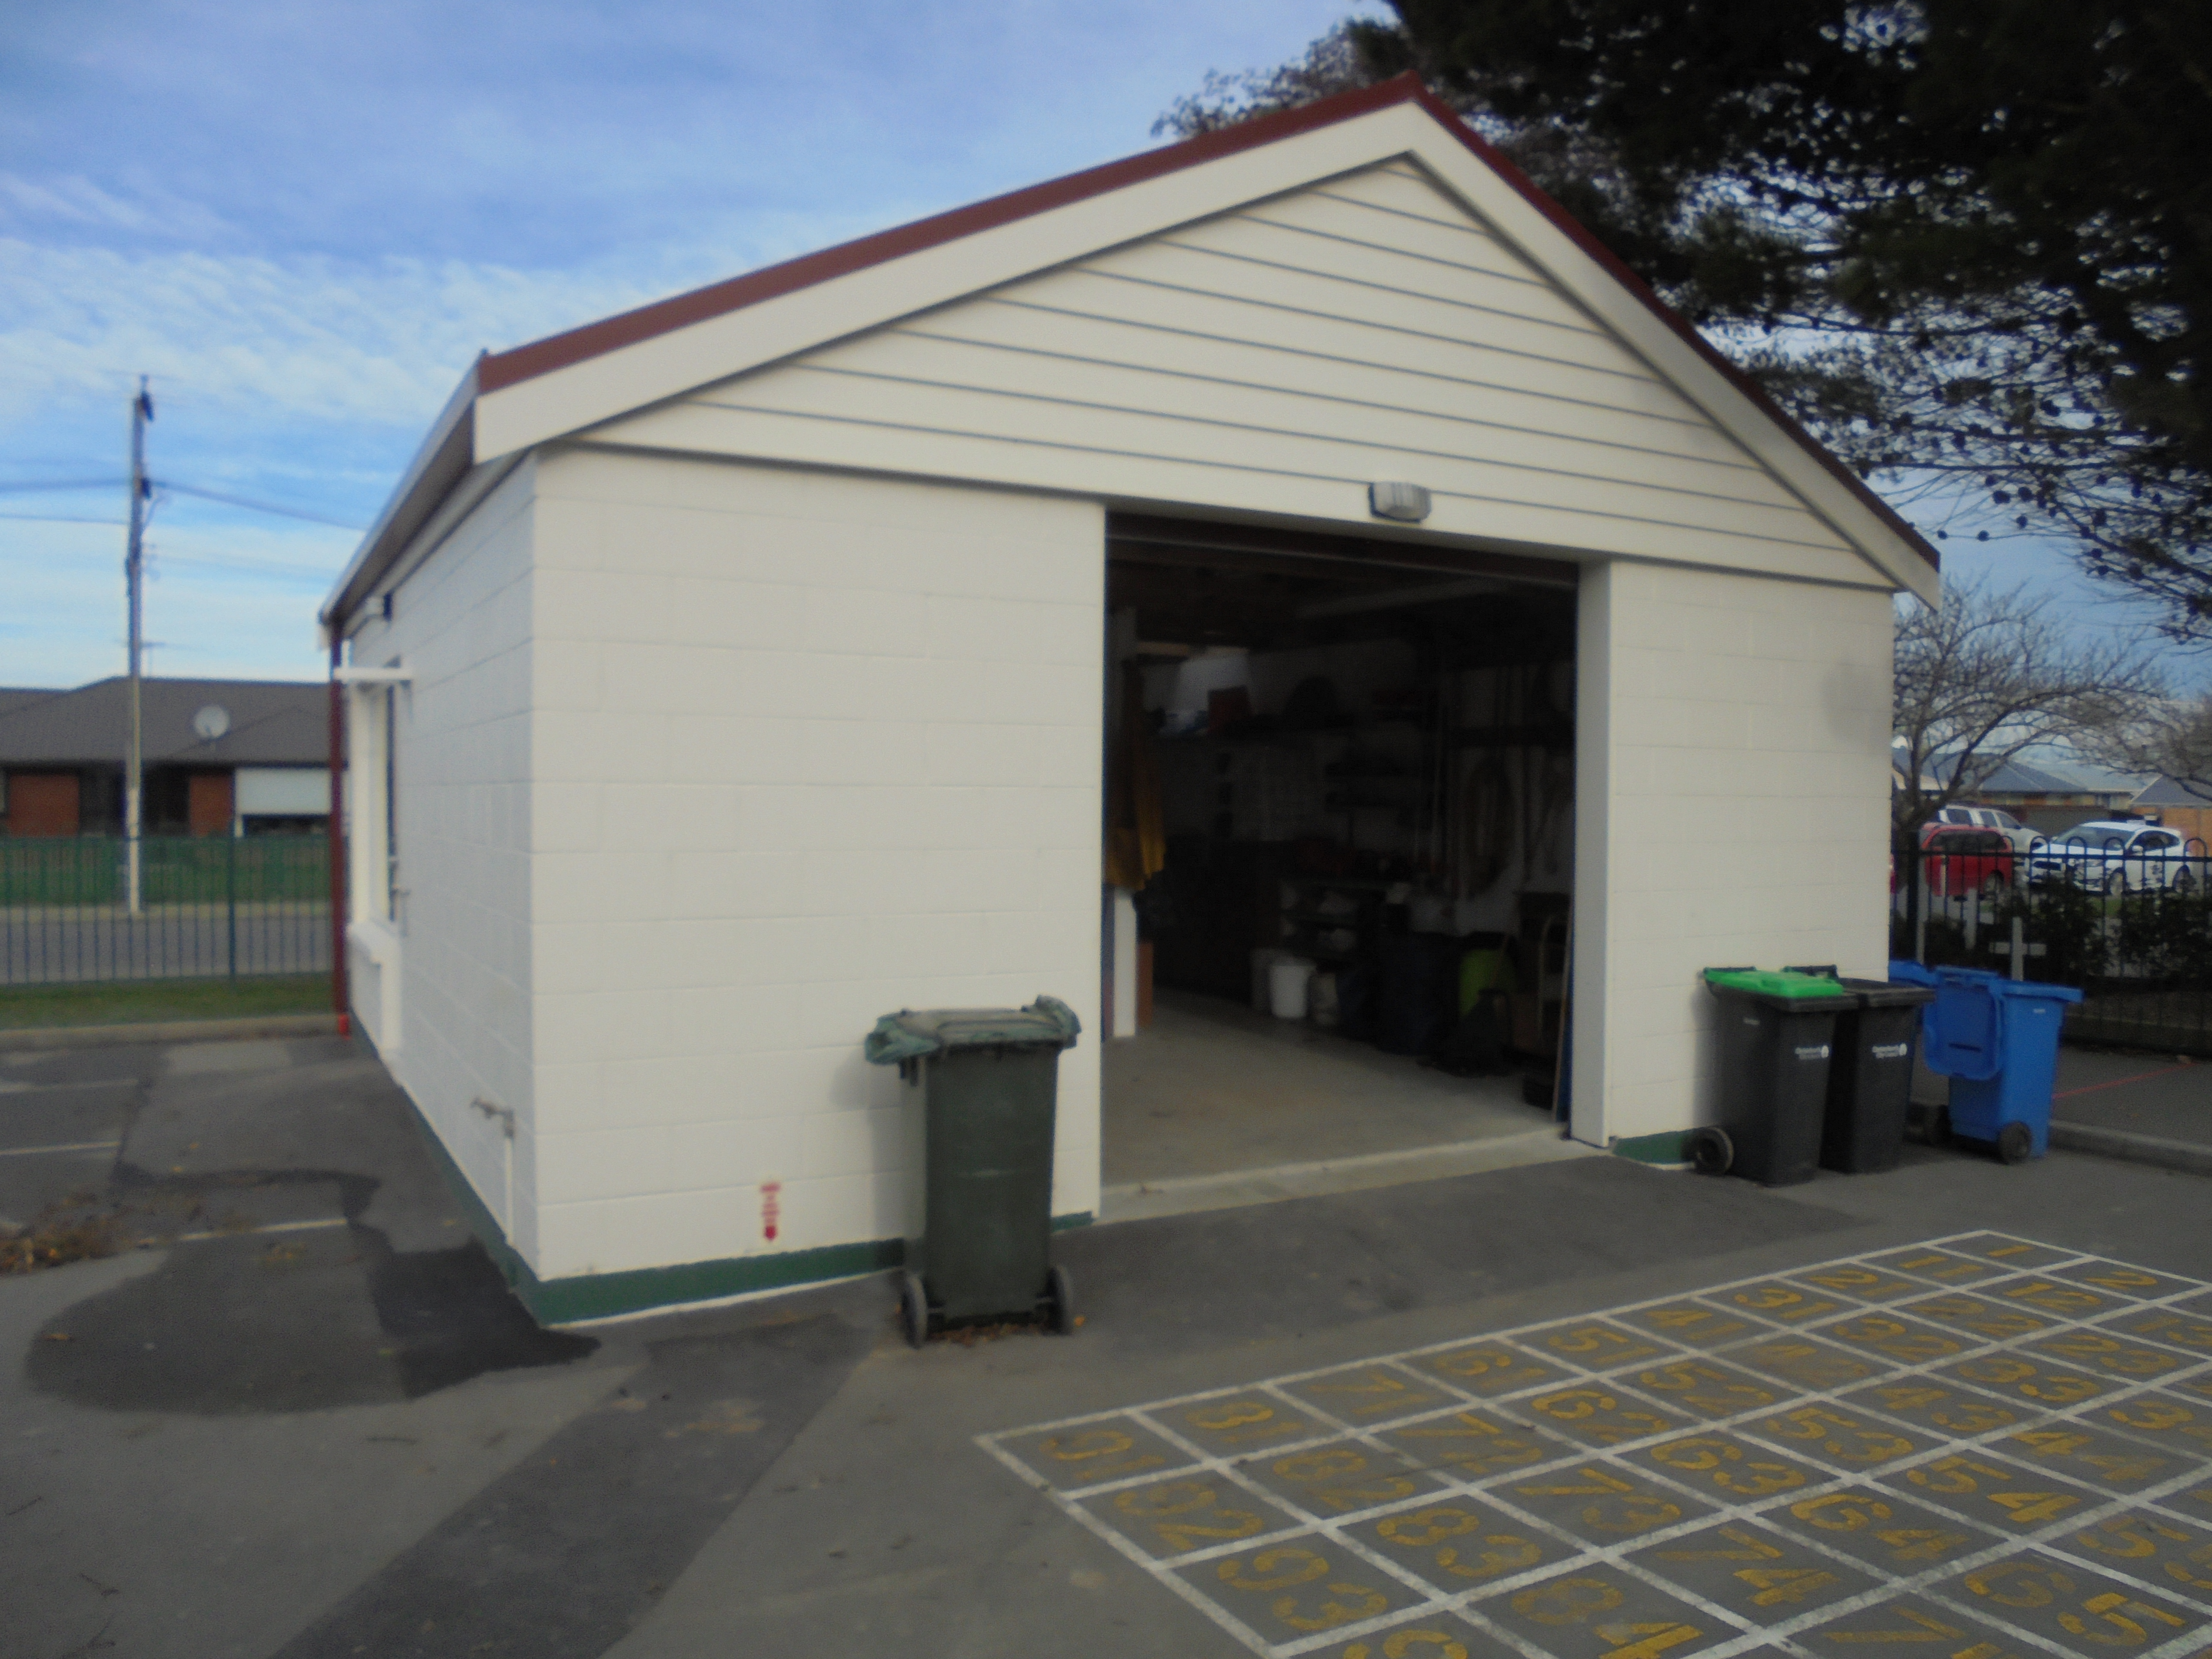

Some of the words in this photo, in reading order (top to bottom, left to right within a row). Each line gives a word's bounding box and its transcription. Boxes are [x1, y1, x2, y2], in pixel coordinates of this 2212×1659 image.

[1902, 1256, 1980, 1276] 11
[1990, 1246, 2030, 1256] 1
[1811, 1270, 1908, 1295] 21
[2007, 1283, 2100, 1310] 12
[2088, 1272, 2156, 1288] 2
[1650, 1311, 1742, 1339] 41
[1736, 1289, 1833, 1318] 31
[1914, 1300, 2042, 1335] 22
[1550, 1328, 1655, 1363] 51
[1835, 1319, 1959, 1359] 32
[2045, 1336, 2176, 1372] 23
[1435, 1350, 1545, 1387] 61
[1642, 1363, 1772, 1412] 52
[1961, 1360, 2098, 1401] 33
[1533, 1390, 1668, 1440] 62
[1878, 1389, 2013, 1431] 43
[2111, 1402, 2212, 1446] 3
[1400, 1412, 1541, 1472] 72
[1768, 1408, 1912, 1460] 53
[2012, 1432, 2166, 1480] 44
[1653, 1439, 1804, 1493] 63
[1518, 1468, 1680, 1530] 73
[1909, 1457, 2081, 1522] 54
[1115, 1483, 1263, 1549] 92
[1792, 1494, 1970, 1559] 64
[1378, 1509, 1540, 1577] 83
[1218, 1549, 1387, 1629] 93
[1660, 1530, 1836, 1606] 74
[1965, 1562, 2185, 1645] 65
